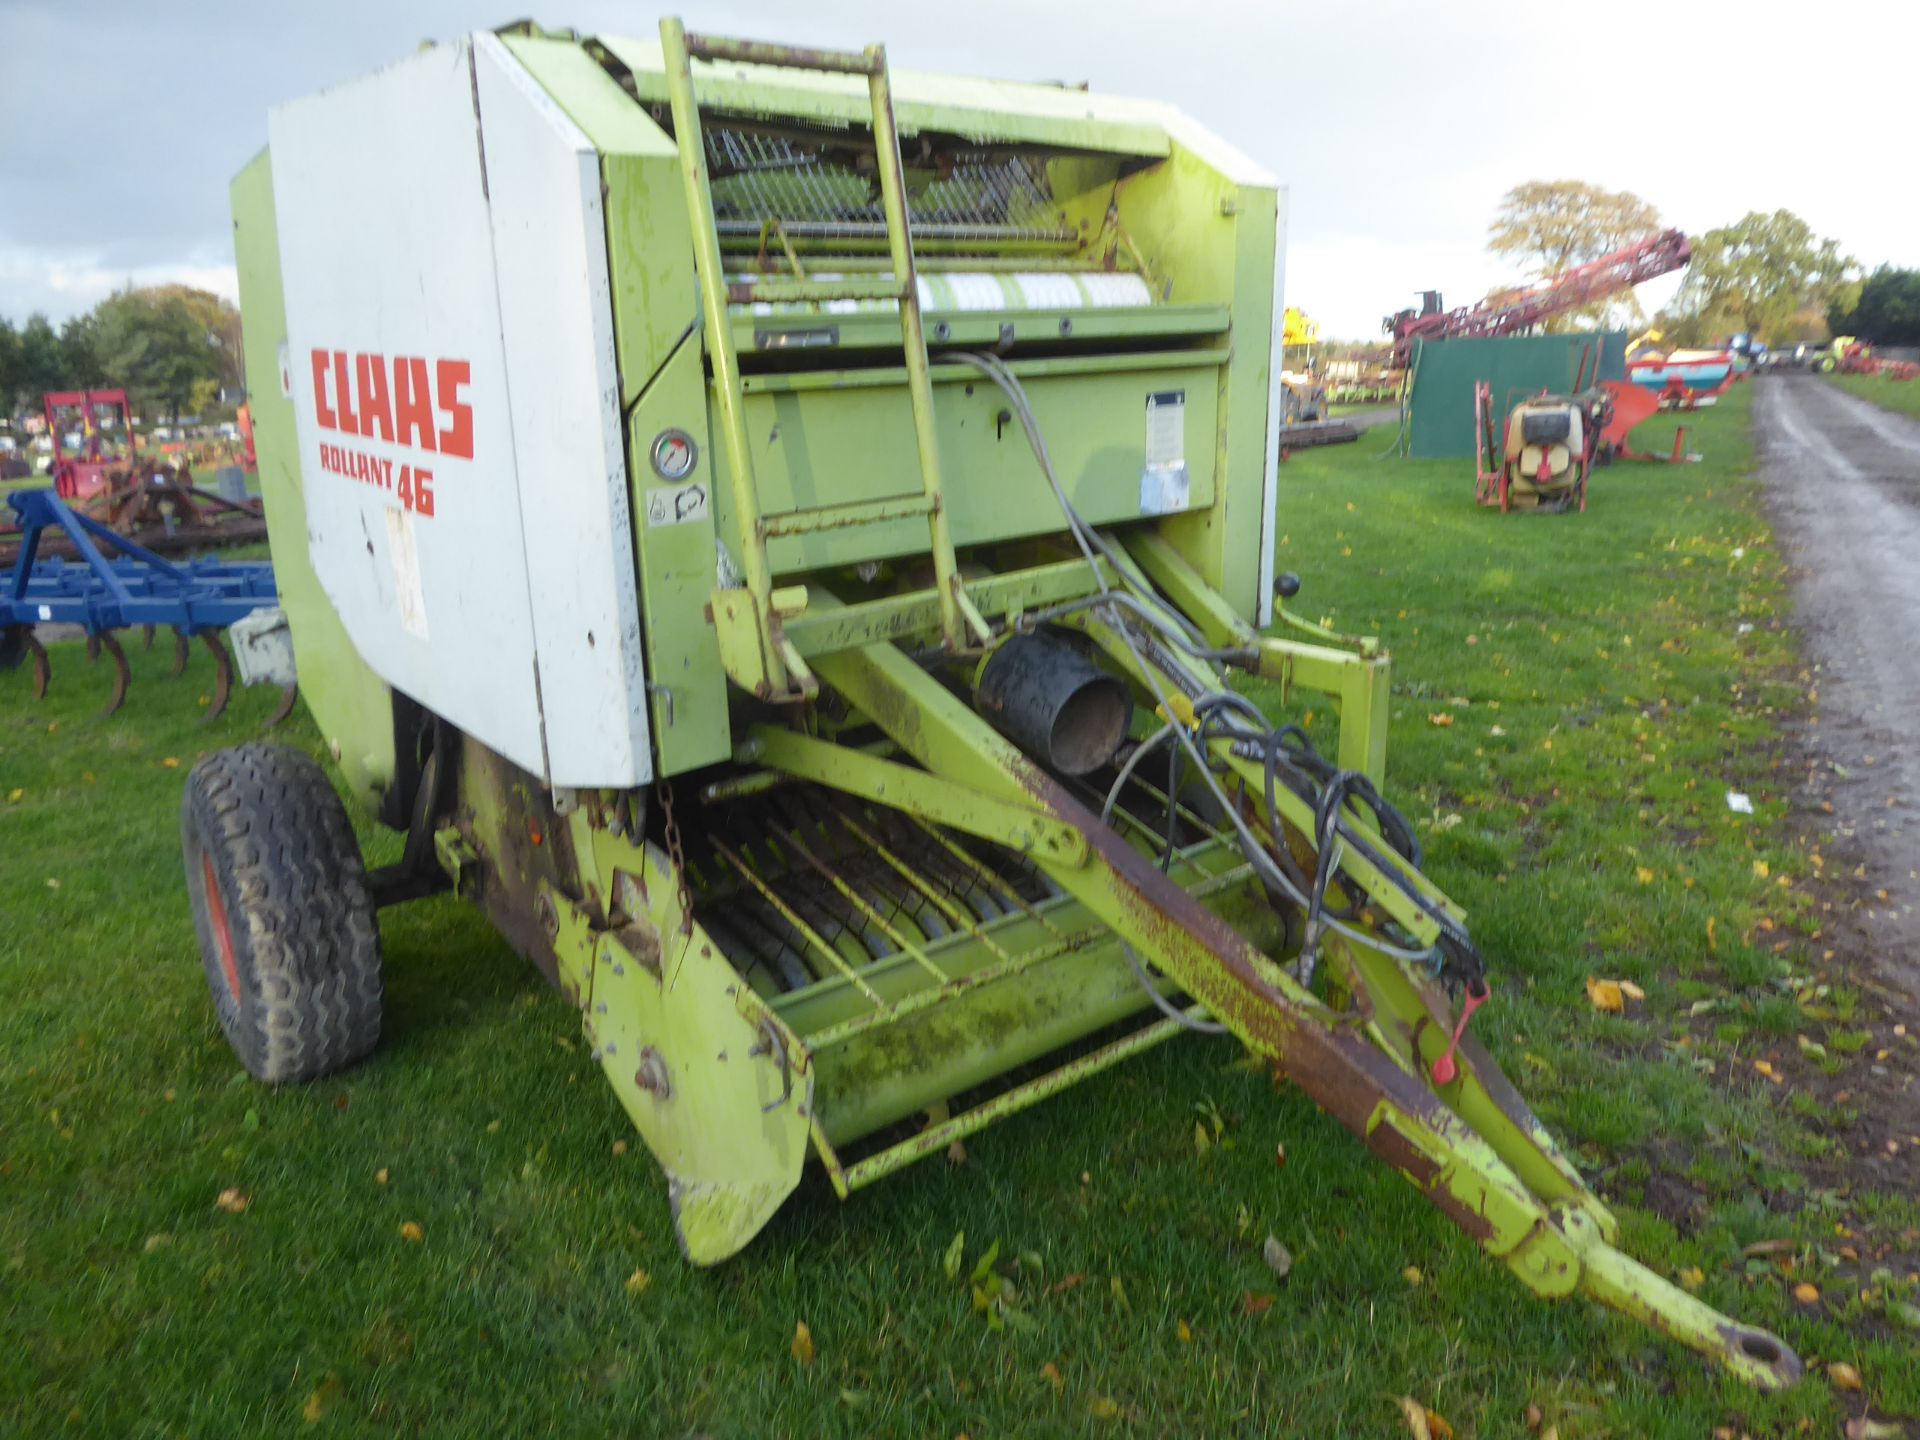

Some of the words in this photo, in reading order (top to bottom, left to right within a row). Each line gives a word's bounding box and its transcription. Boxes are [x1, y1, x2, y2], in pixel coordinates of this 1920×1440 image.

[311, 348, 473, 460] CLAAS
[320, 443, 392, 490] ROLLANT
[398, 464, 434, 518] 46
